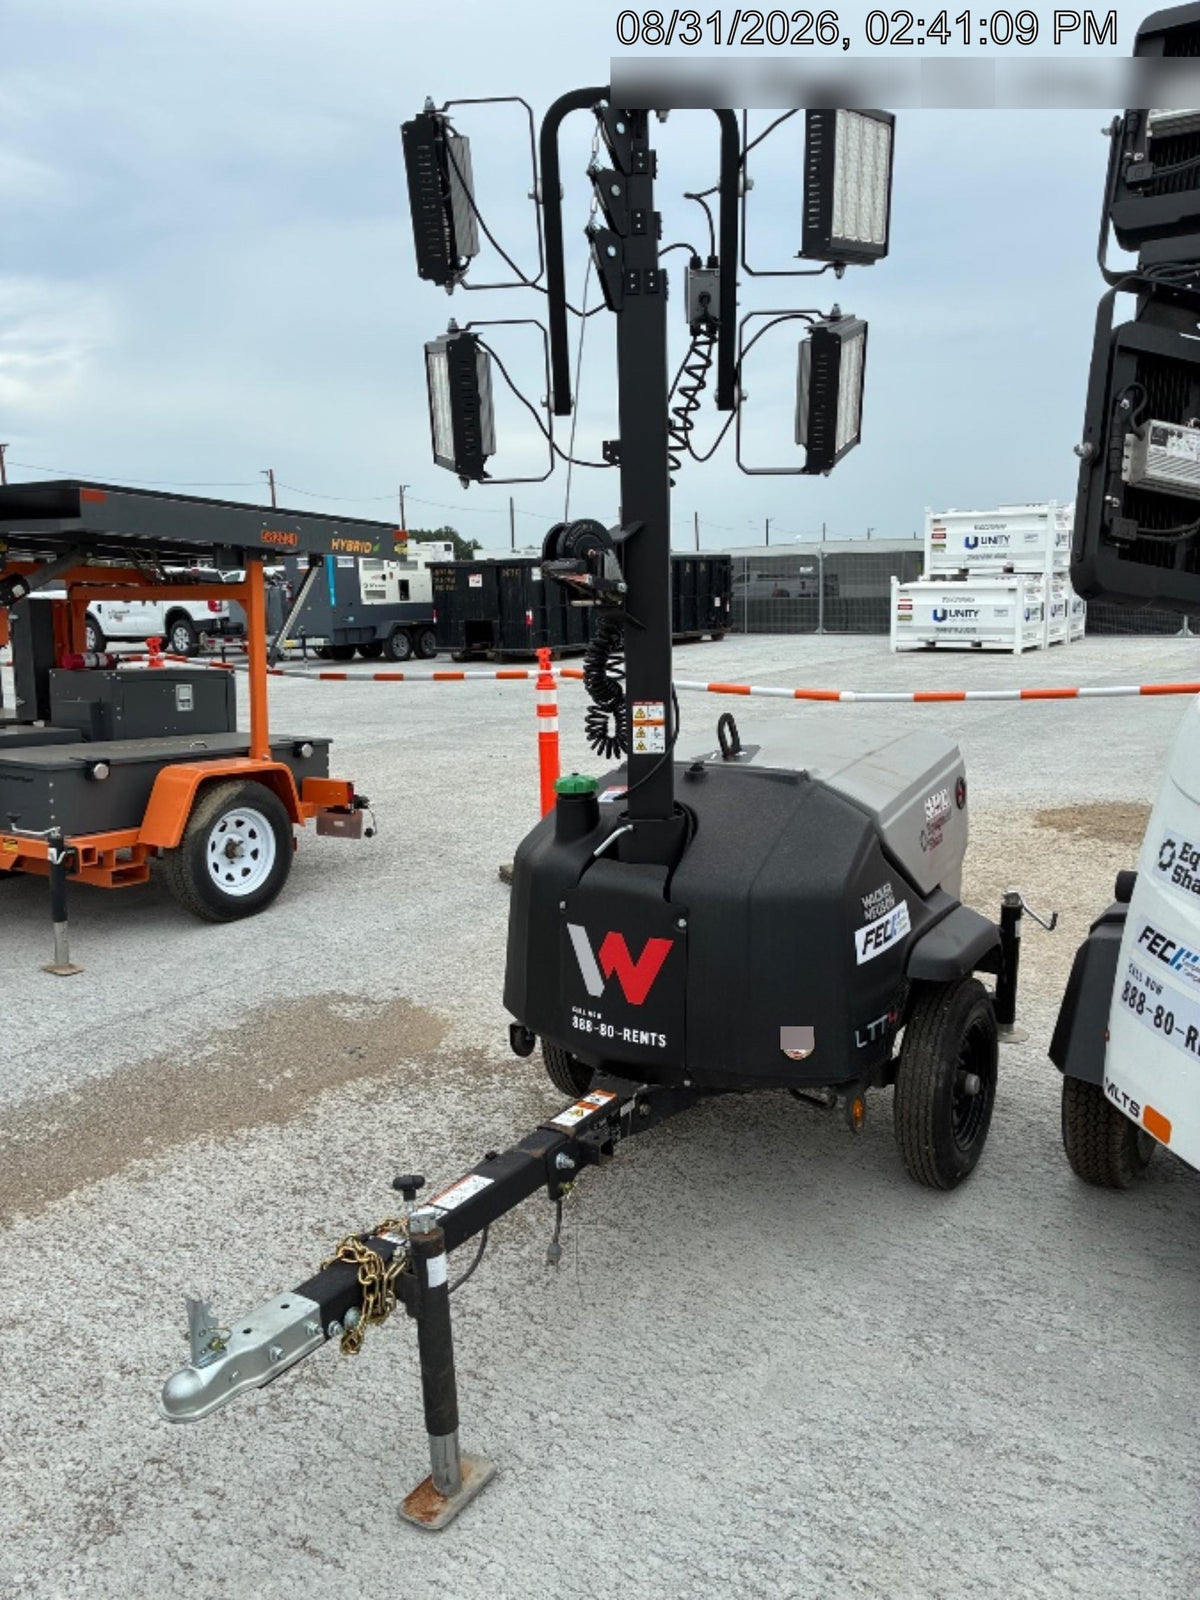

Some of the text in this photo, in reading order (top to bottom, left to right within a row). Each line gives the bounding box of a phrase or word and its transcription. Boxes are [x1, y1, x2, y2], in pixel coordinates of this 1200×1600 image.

[331, 538, 372, 554] HYBRID
[949, 609, 980, 618] UNITY
[1138, 925, 1178, 966] FEC
[572, 1016, 667, 1048] 888-80-RENTS
[1121, 980, 1200, 1057] 888-80-R
